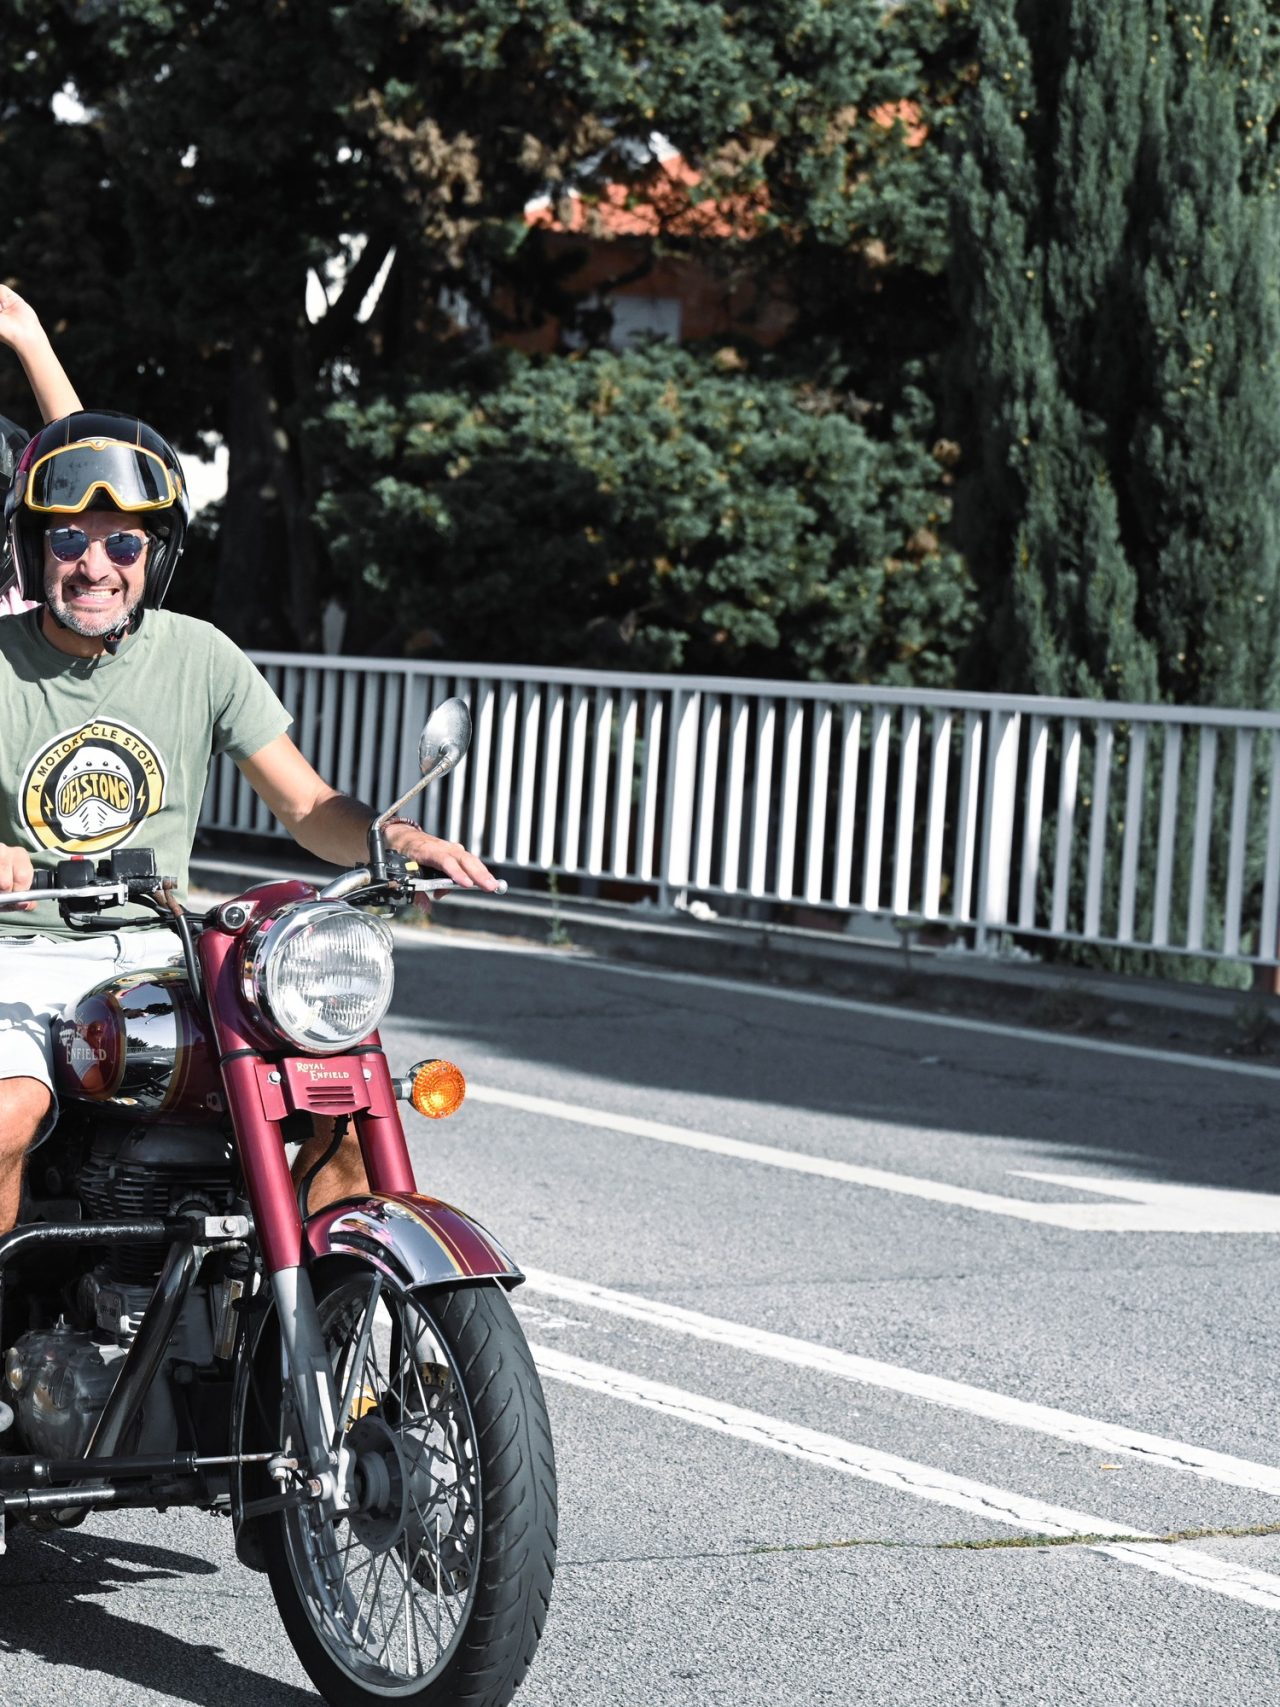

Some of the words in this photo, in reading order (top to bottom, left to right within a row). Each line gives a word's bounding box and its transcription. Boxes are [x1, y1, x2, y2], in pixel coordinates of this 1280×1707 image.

[31, 783, 41, 793] A
[123, 737, 156, 776] STORY
[61, 773, 130, 814] HELSTONS
[66, 1043, 107, 1065] ENFIELD
[296, 1062, 325, 1072] ROYAL
[310, 1070, 350, 1081] ENFIELD
